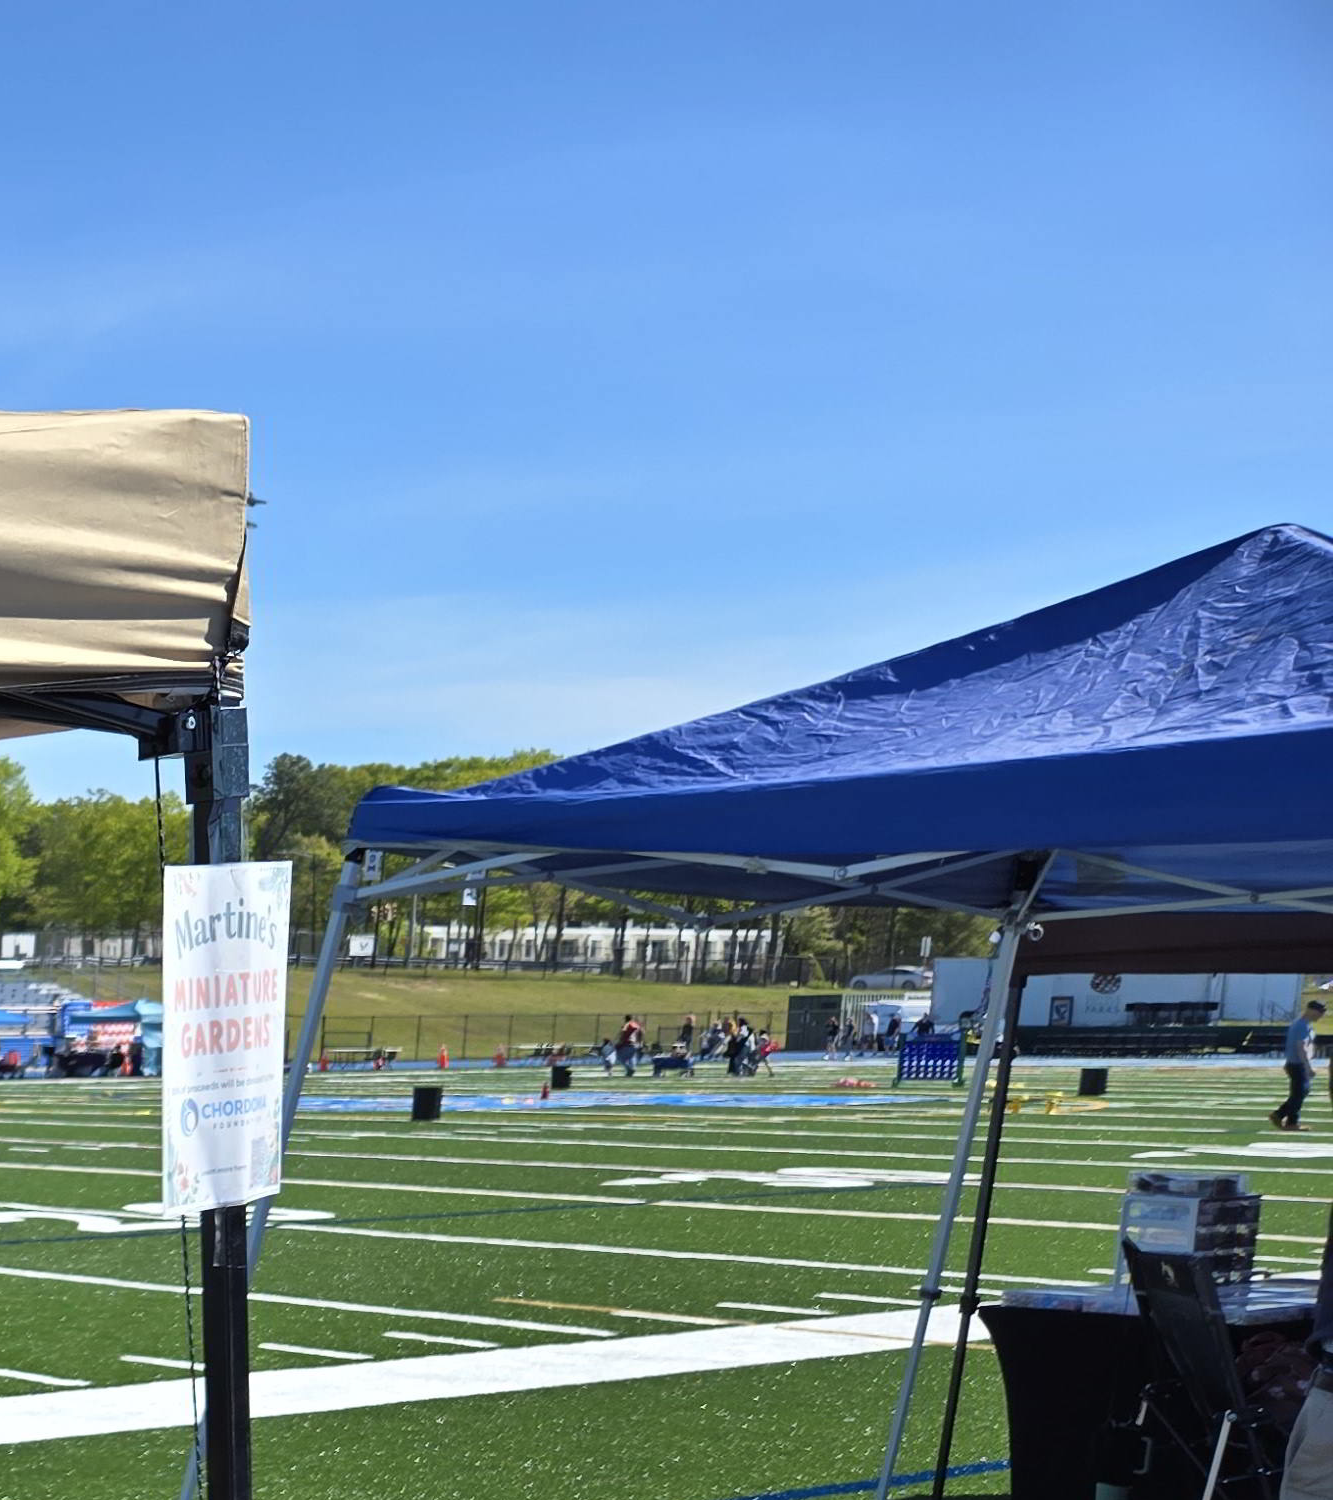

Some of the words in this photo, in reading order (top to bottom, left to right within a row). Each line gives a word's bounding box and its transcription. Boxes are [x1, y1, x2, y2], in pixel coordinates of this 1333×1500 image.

[175, 898, 278, 960] Martine's
[174, 968, 278, 1013] MINIATURE
[181, 1013, 271, 1059] GARDENS
